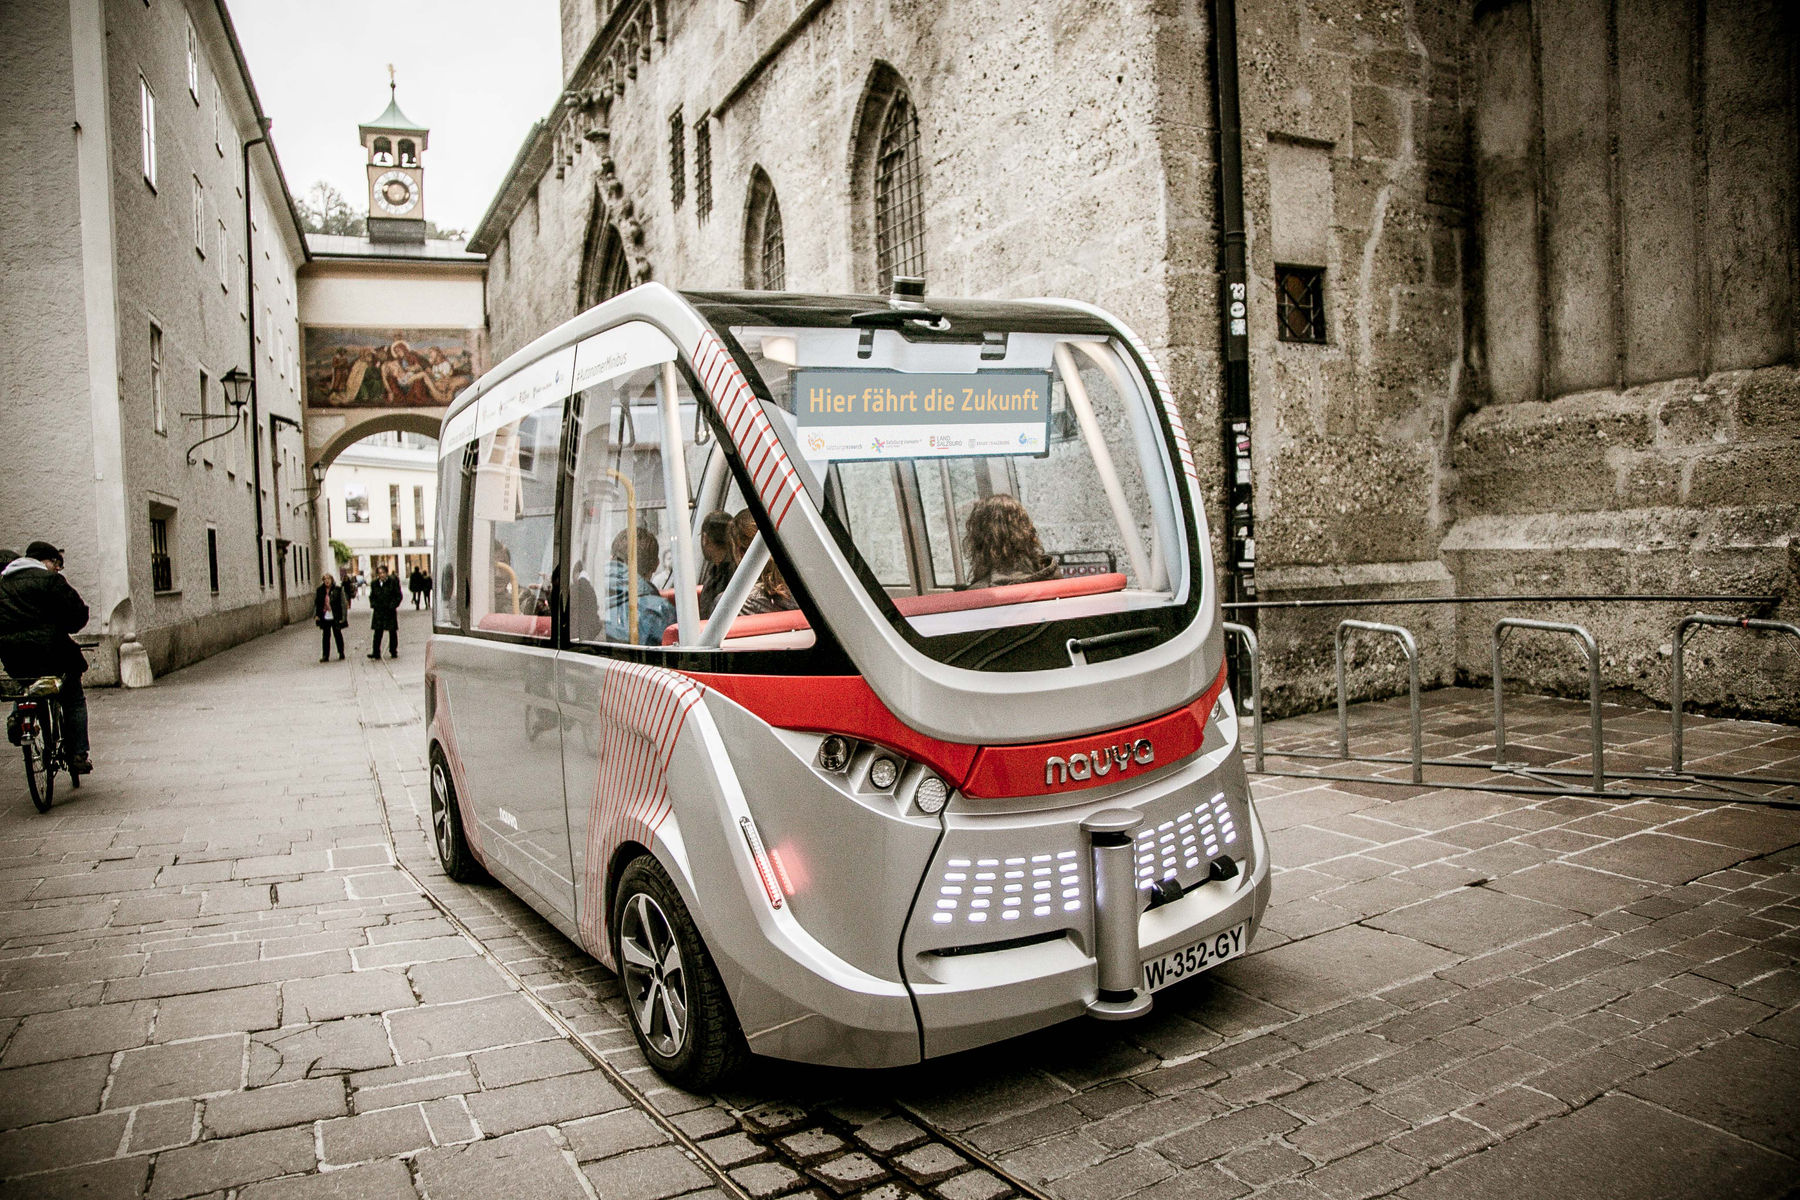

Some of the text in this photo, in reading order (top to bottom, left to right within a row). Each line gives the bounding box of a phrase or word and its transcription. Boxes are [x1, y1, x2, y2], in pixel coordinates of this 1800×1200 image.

[809, 387, 1039, 413] Hier fährt die Zukunft
[1144, 924, 1244, 991] W-352-GY
